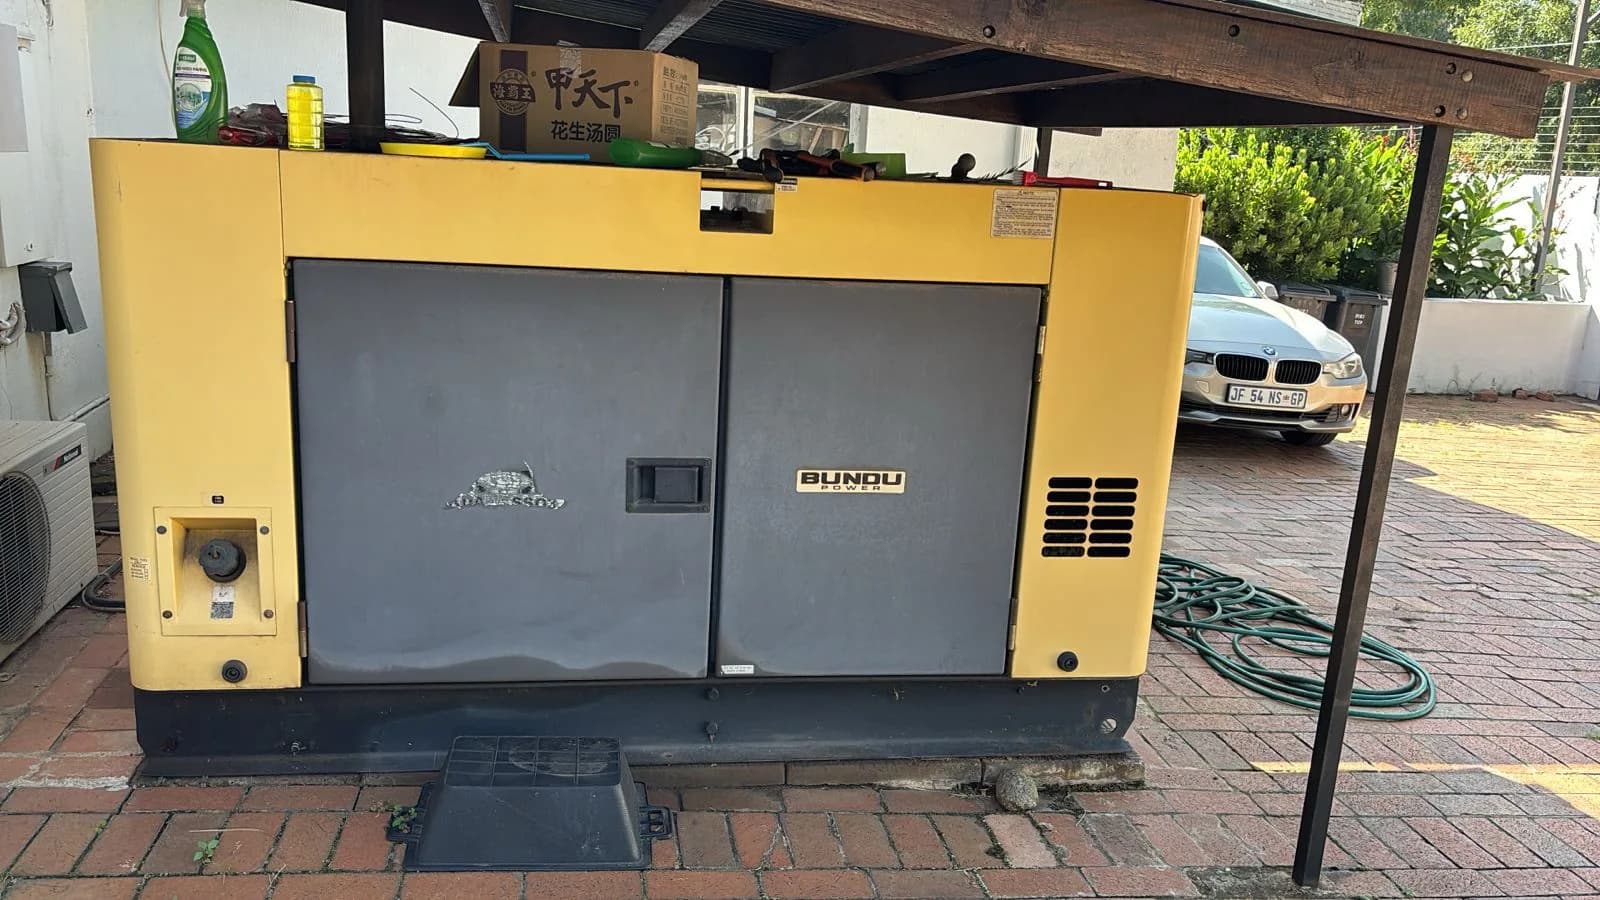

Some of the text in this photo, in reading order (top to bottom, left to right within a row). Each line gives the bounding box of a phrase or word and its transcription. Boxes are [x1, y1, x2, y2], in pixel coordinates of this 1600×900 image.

[545, 68, 634, 118] 甲天下
[551, 120, 621, 143] 花生汤圆
[1231, 387, 1304, 406] JF 54 NS GP
[801, 472, 902, 485] BUNDU
